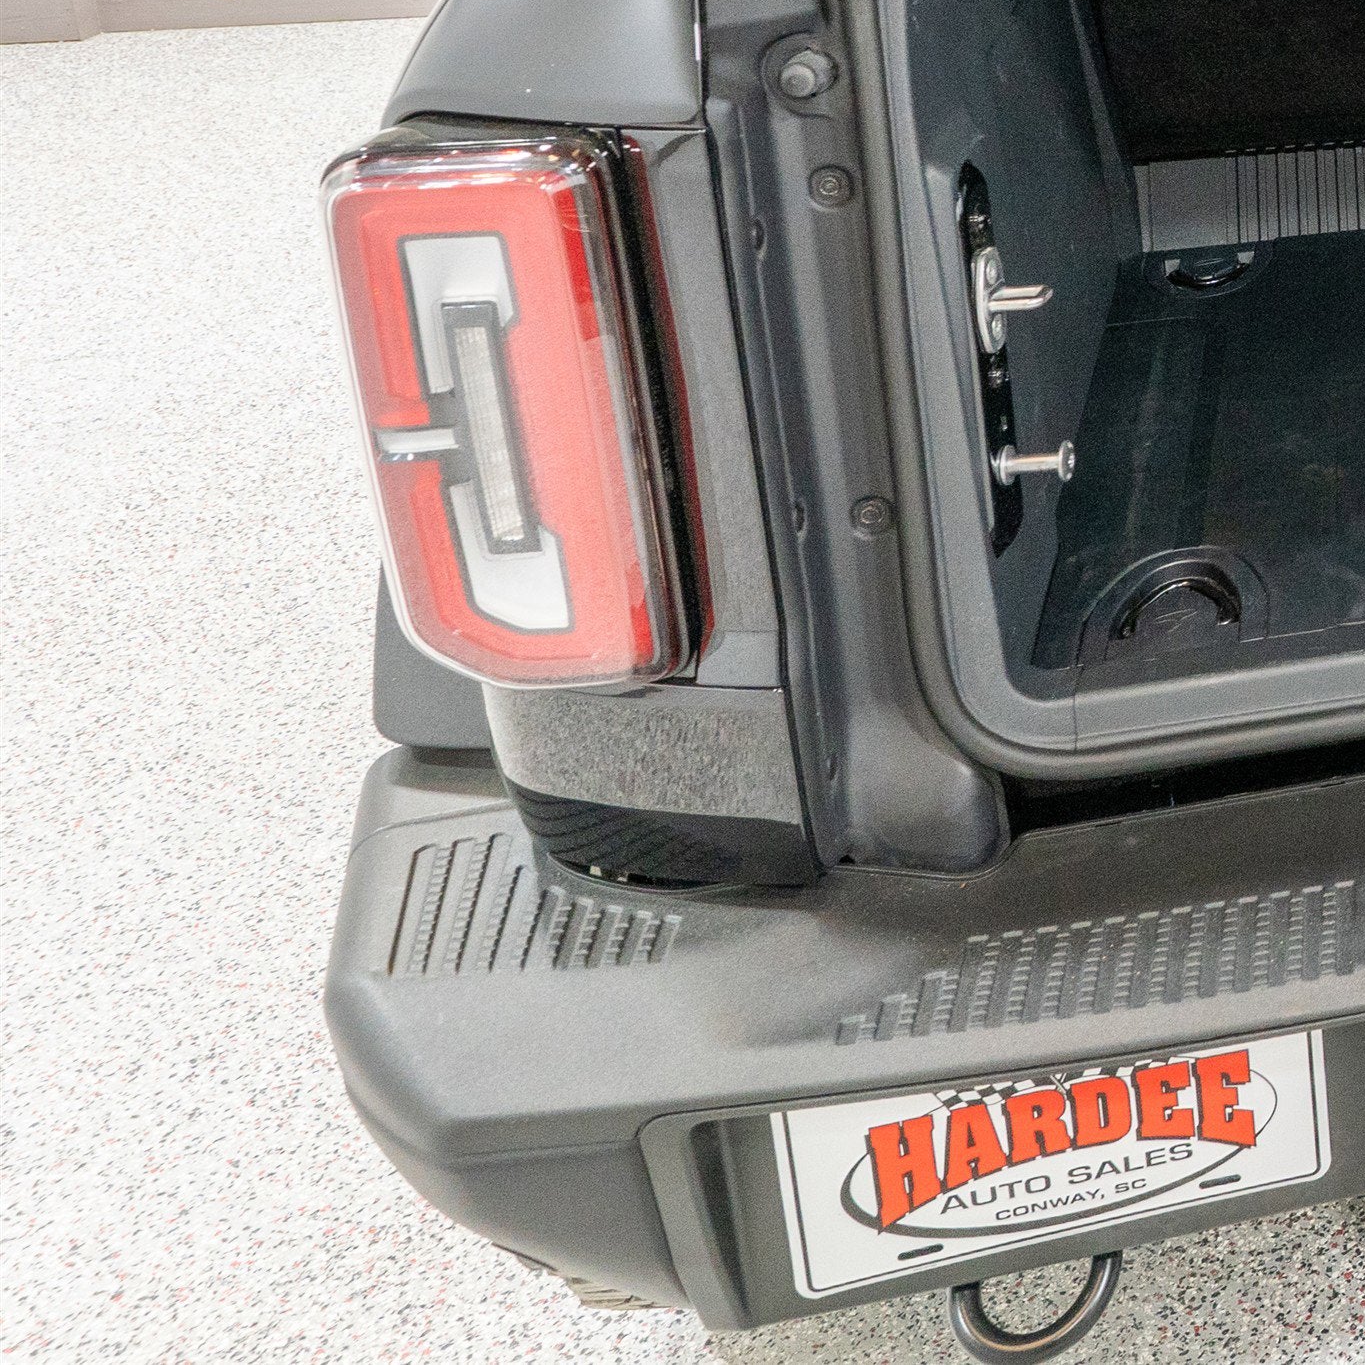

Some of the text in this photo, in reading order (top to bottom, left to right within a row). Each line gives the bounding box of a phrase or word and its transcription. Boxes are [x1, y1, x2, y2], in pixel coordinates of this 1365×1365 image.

[867, 1049, 1257, 1233] HARDEE
[941, 1142, 1193, 1214] AUTO SALES
[995, 1178, 1146, 1221] CONWAY, SC
